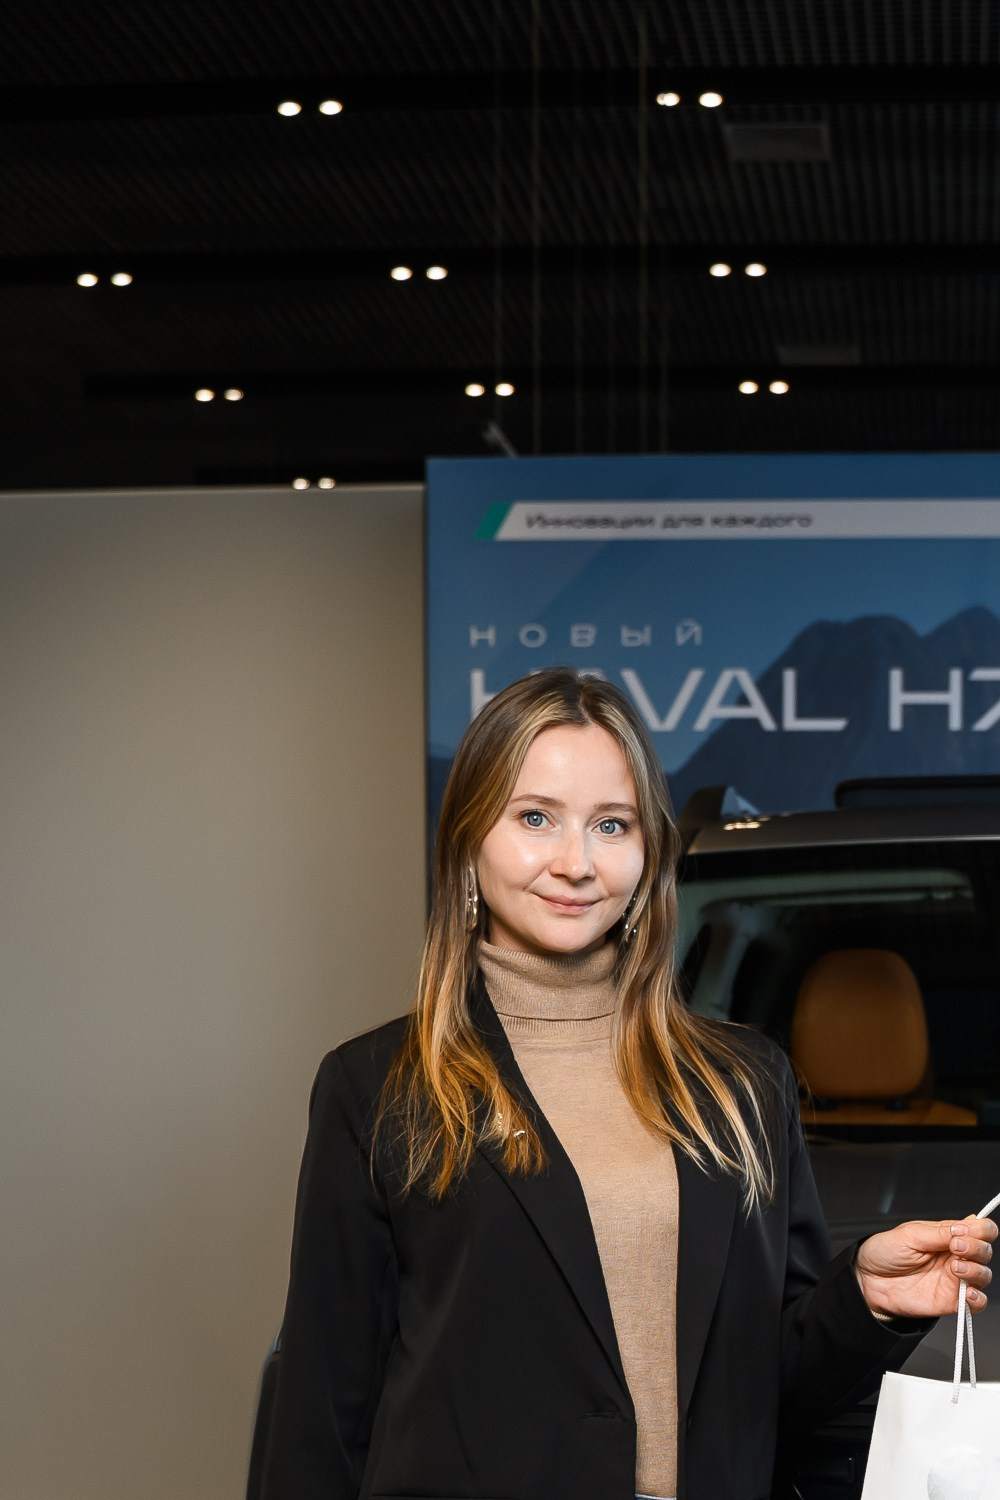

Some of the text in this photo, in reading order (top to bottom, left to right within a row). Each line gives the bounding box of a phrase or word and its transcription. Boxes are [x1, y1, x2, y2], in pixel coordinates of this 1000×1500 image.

[525, 512, 814, 530] Инновации для каждого
[470, 667, 849, 732] VAL
